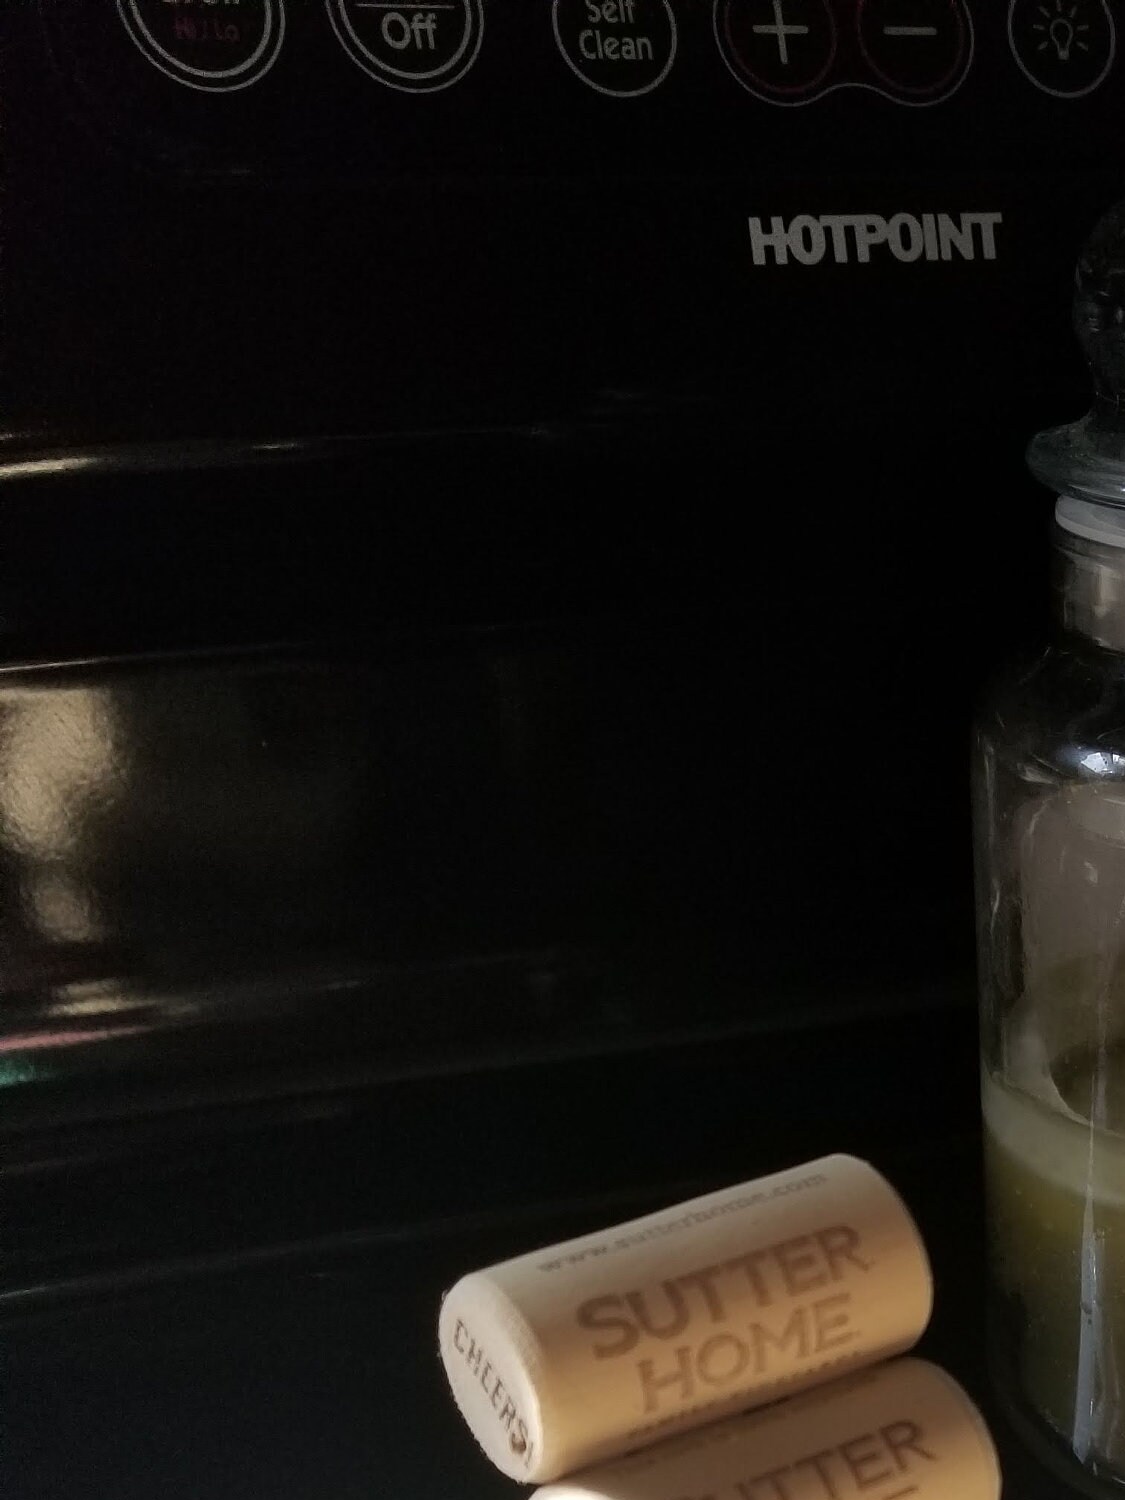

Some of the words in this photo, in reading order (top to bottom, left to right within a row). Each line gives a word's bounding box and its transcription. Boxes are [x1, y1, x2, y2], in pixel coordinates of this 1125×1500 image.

[381, 11, 438, 51] Off
[579, 29, 653, 60] Clean
[747, 211, 1003, 266] HOTPOINT
[577, 1225, 870, 1360] SUTTER
[637, 1293, 853, 1414] HOME
